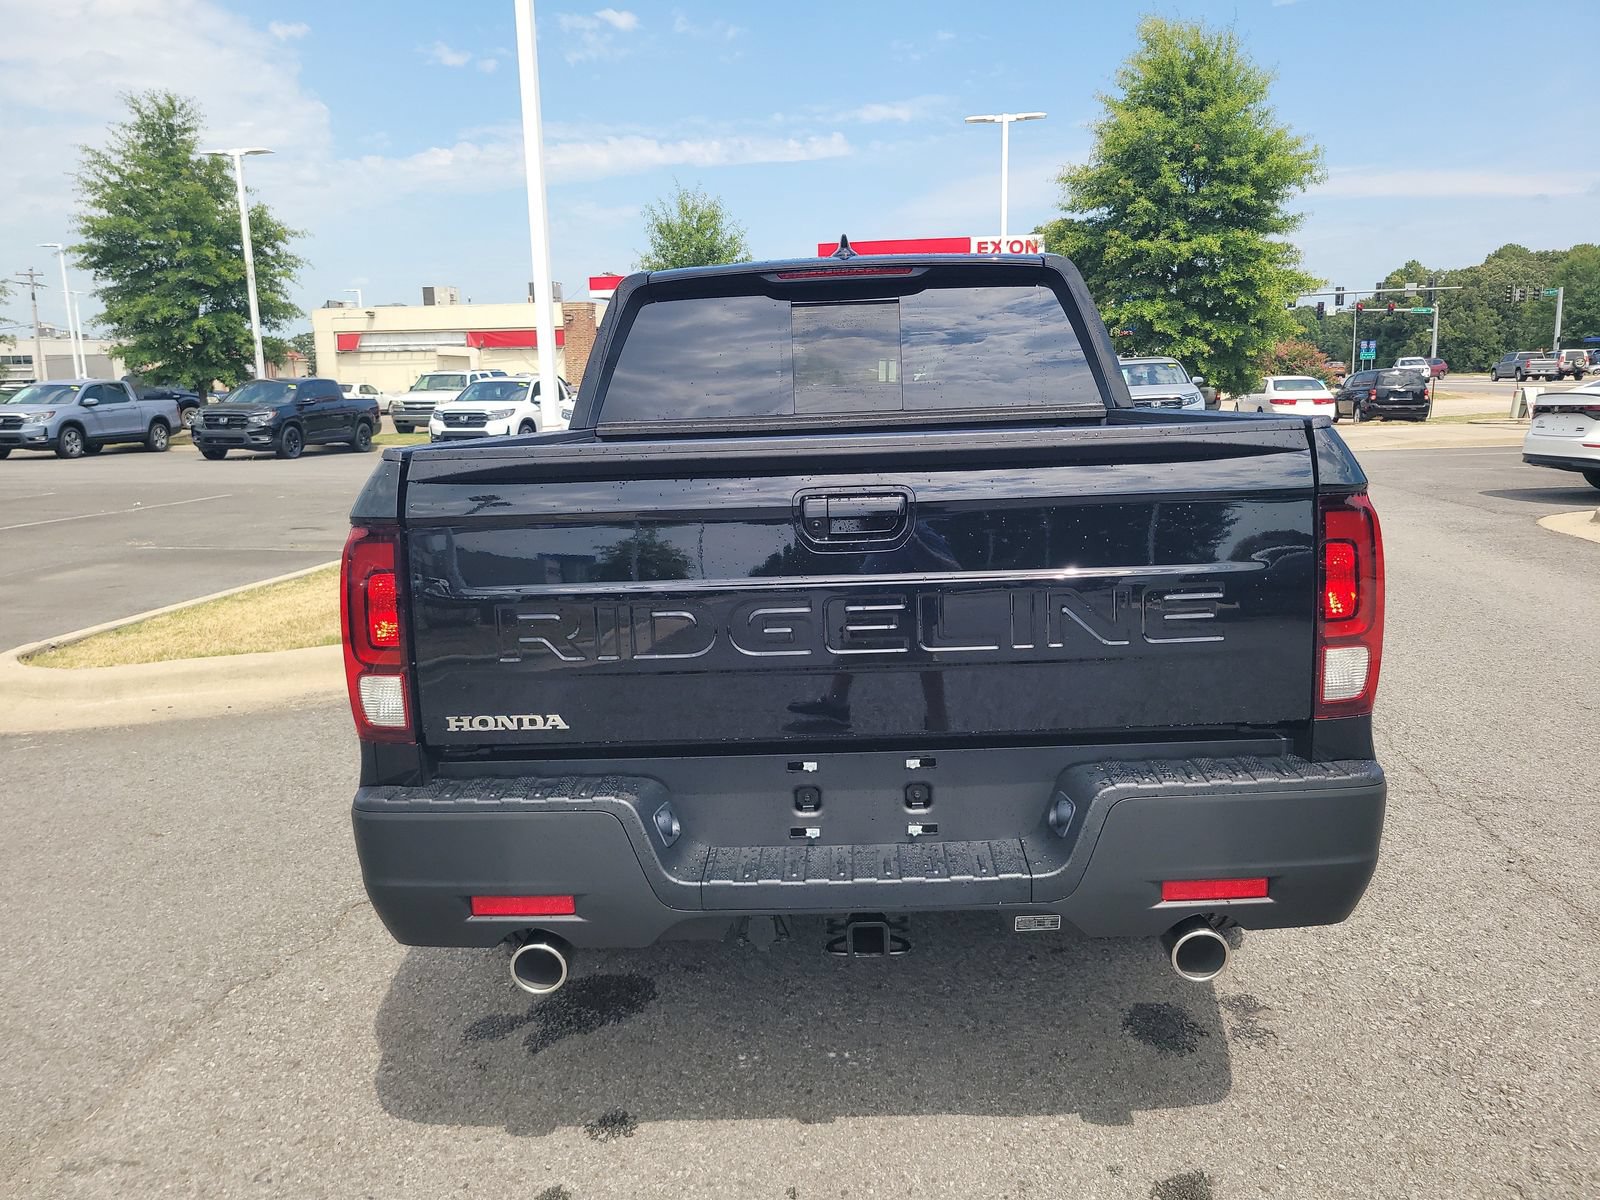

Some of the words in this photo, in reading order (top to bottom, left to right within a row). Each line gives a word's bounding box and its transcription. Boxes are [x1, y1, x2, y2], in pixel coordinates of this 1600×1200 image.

[977, 239, 1038, 254] EXON
[495, 582, 1225, 662] RIDGELINE
[445, 714, 570, 731] HONDA
